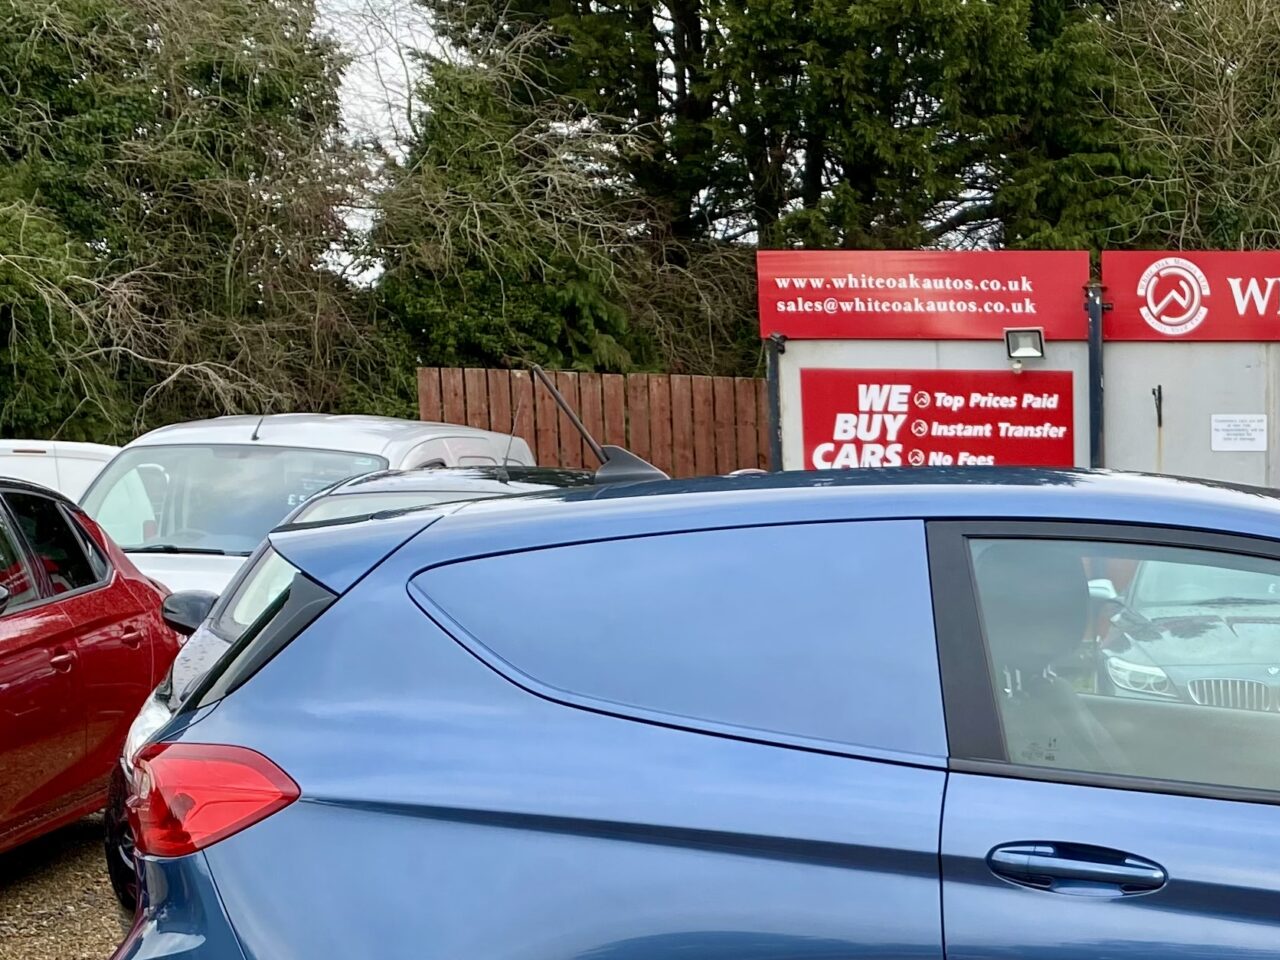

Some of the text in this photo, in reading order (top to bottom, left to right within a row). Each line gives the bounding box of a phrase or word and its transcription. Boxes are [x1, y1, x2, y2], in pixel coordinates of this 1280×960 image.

[775, 273, 1033, 292] www.whiteoakautos.co.uk
[776, 297, 1037, 314] sales@whiteoakautos.co.uk
[857, 384, 912, 412] WE
[934, 392, 1059, 412] Top Prices Paid
[832, 413, 907, 442] BUY
[930, 421, 1067, 439] Instant Transfer
[812, 443, 903, 470] CARS
[927, 451, 995, 466] No Fees
